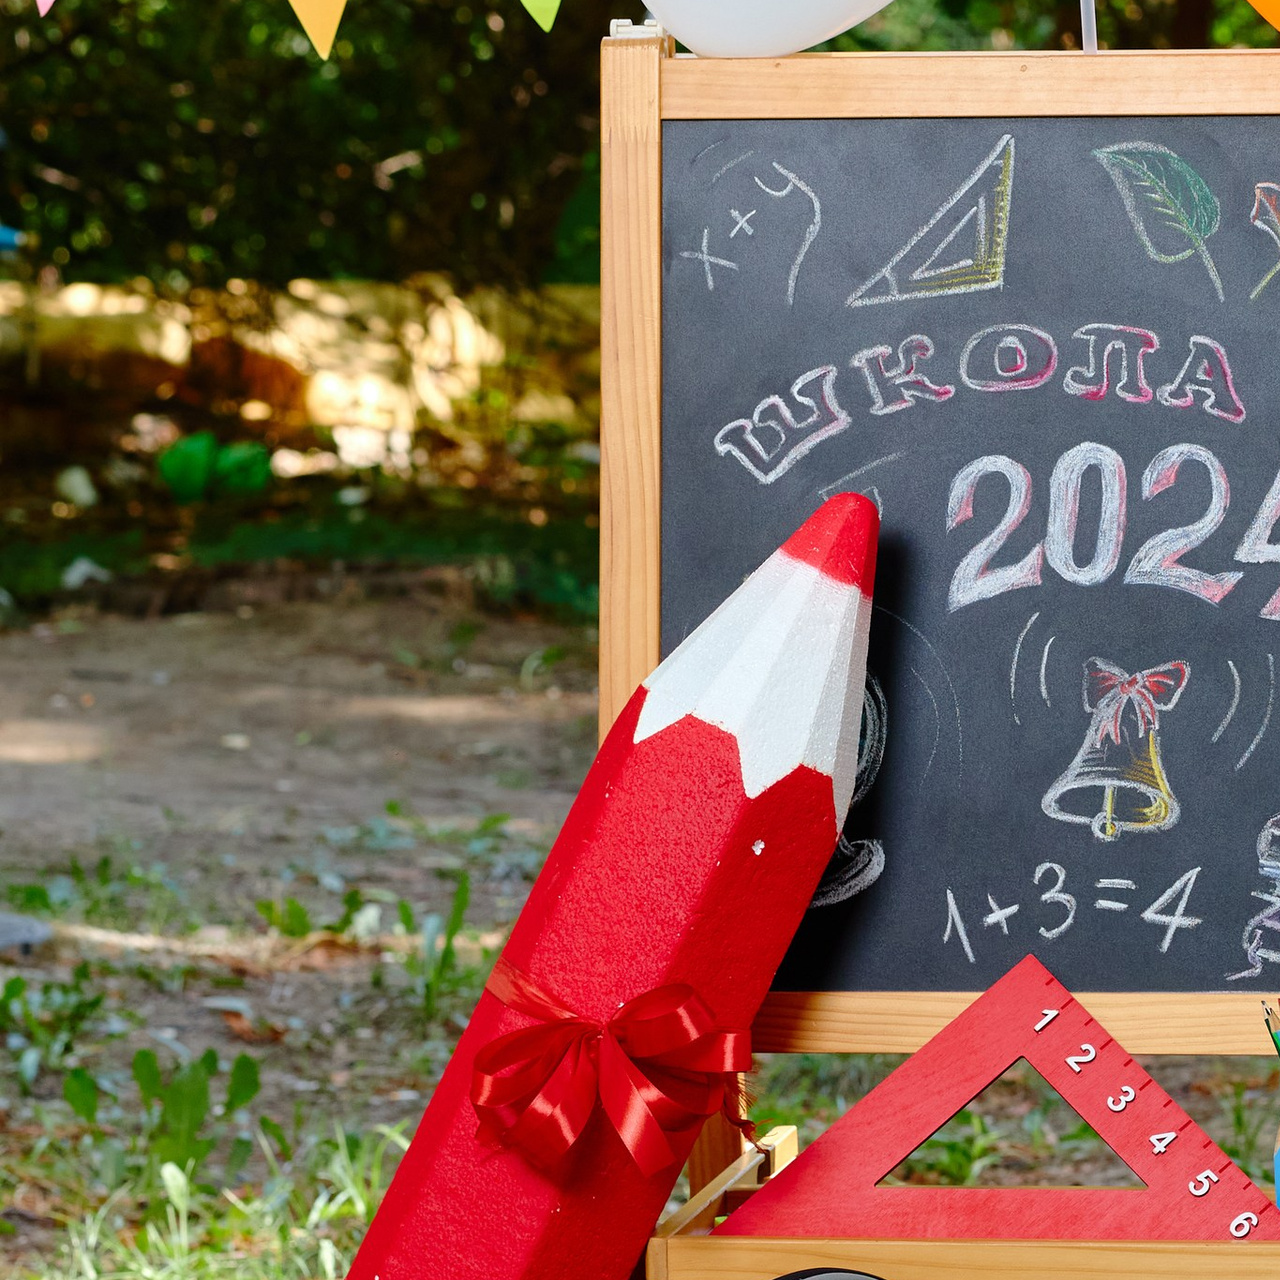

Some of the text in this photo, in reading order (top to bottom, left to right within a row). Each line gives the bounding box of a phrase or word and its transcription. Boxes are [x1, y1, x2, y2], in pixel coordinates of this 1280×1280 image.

[1032, 1008, 1258, 1238] 1 2 3 4 5 6
